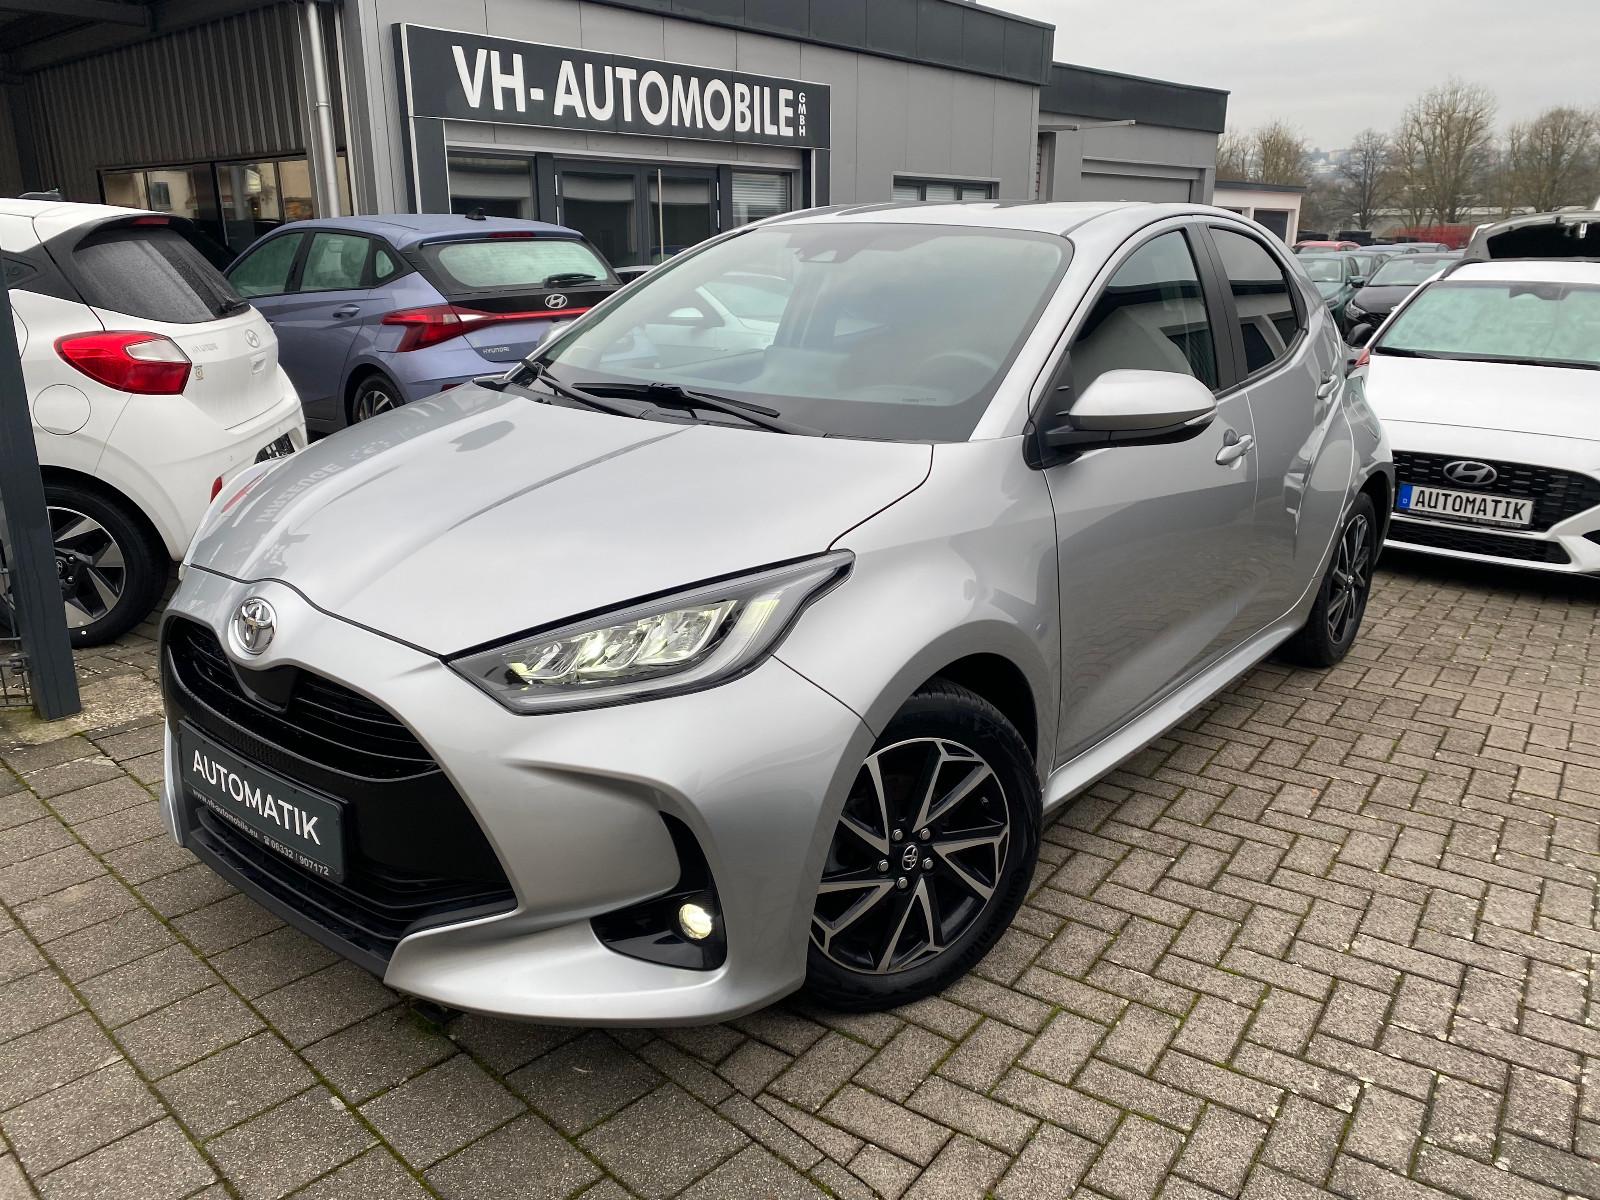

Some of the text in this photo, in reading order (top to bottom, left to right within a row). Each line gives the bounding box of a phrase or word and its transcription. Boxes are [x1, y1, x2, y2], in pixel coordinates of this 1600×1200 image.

[451, 45, 794, 137] VH- AUTOMOBILE
[798, 92, 806, 136] GMBH
[1415, 490, 1527, 520] AUTOMATIK
[193, 750, 321, 845] AUTOMATIK
[271, 840, 293, 859] 06332
[300, 856, 329, 876] 907172
